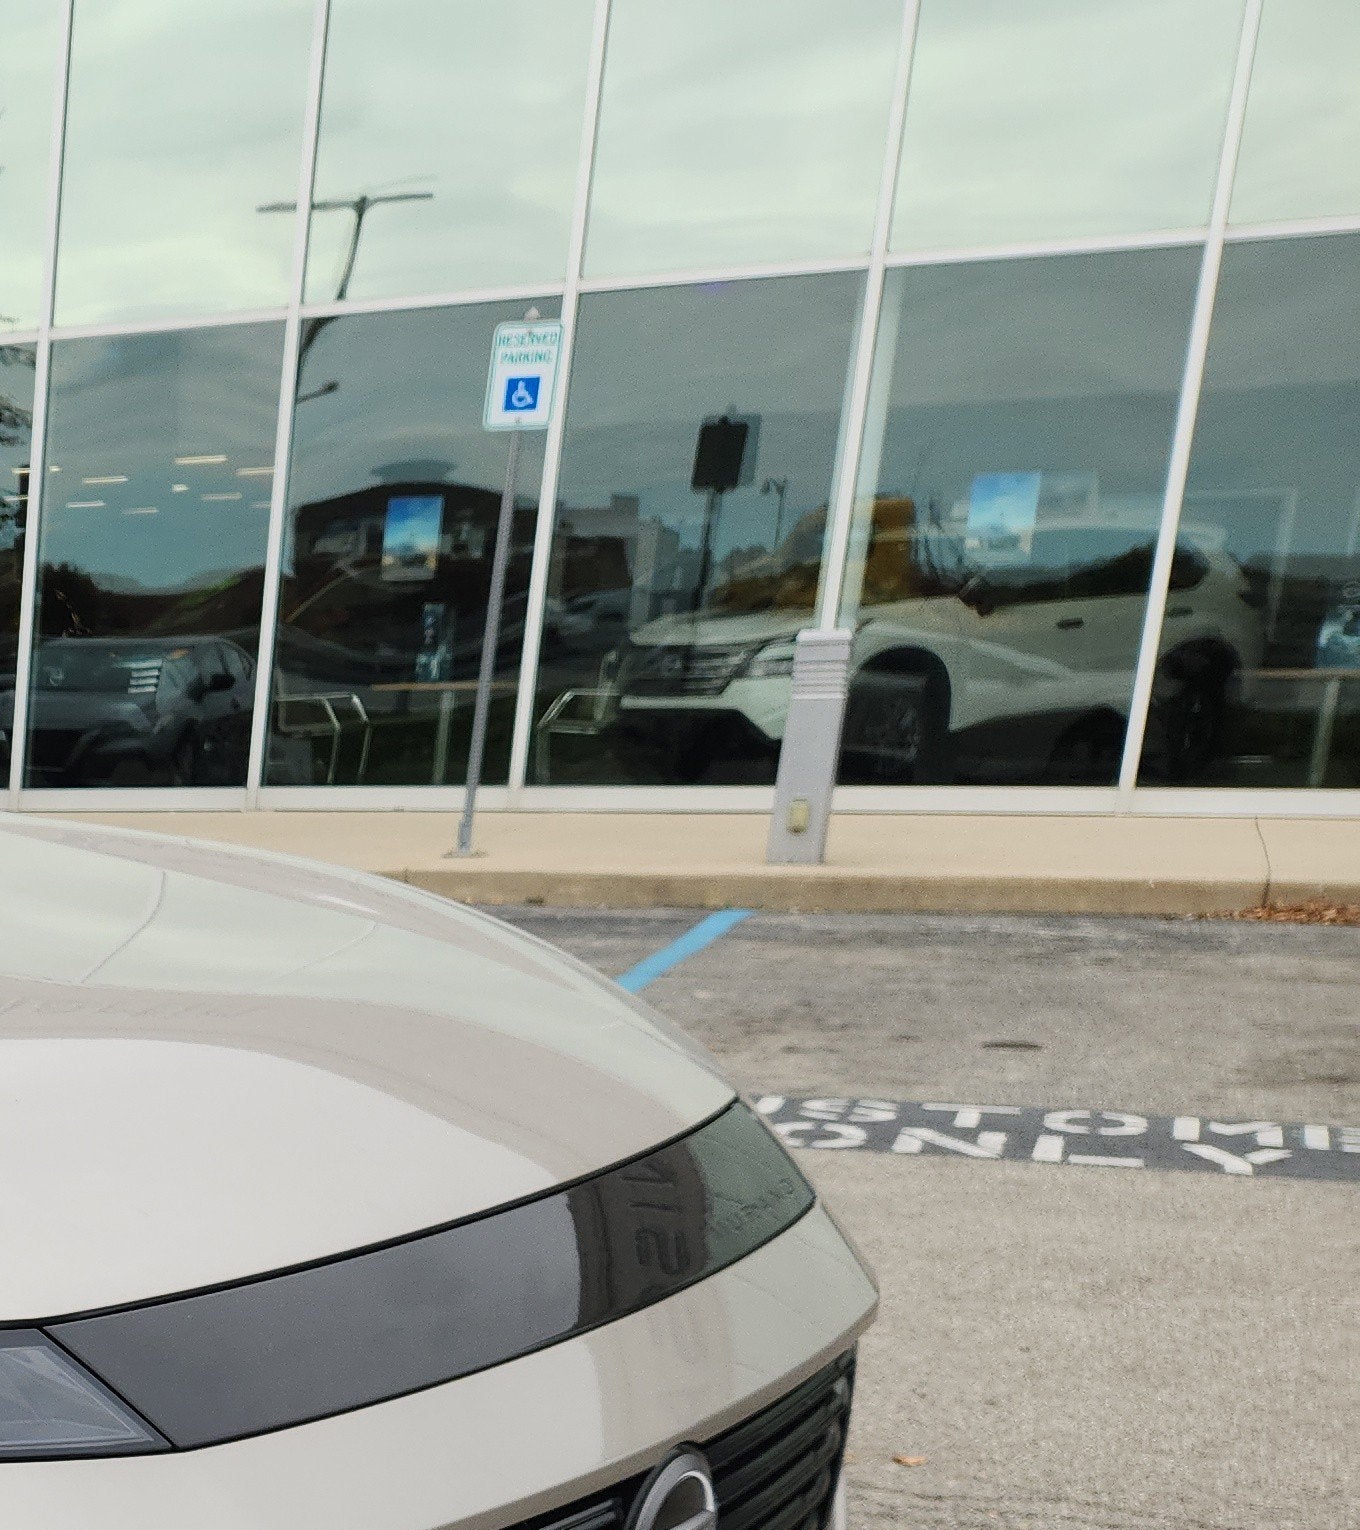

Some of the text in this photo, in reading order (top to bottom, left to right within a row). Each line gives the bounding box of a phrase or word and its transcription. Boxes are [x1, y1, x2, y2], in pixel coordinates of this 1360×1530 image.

[496, 331, 558, 346] RESERVED
[500, 349, 552, 364] PARKING
[773, 1120, 1293, 1176] ONLY
